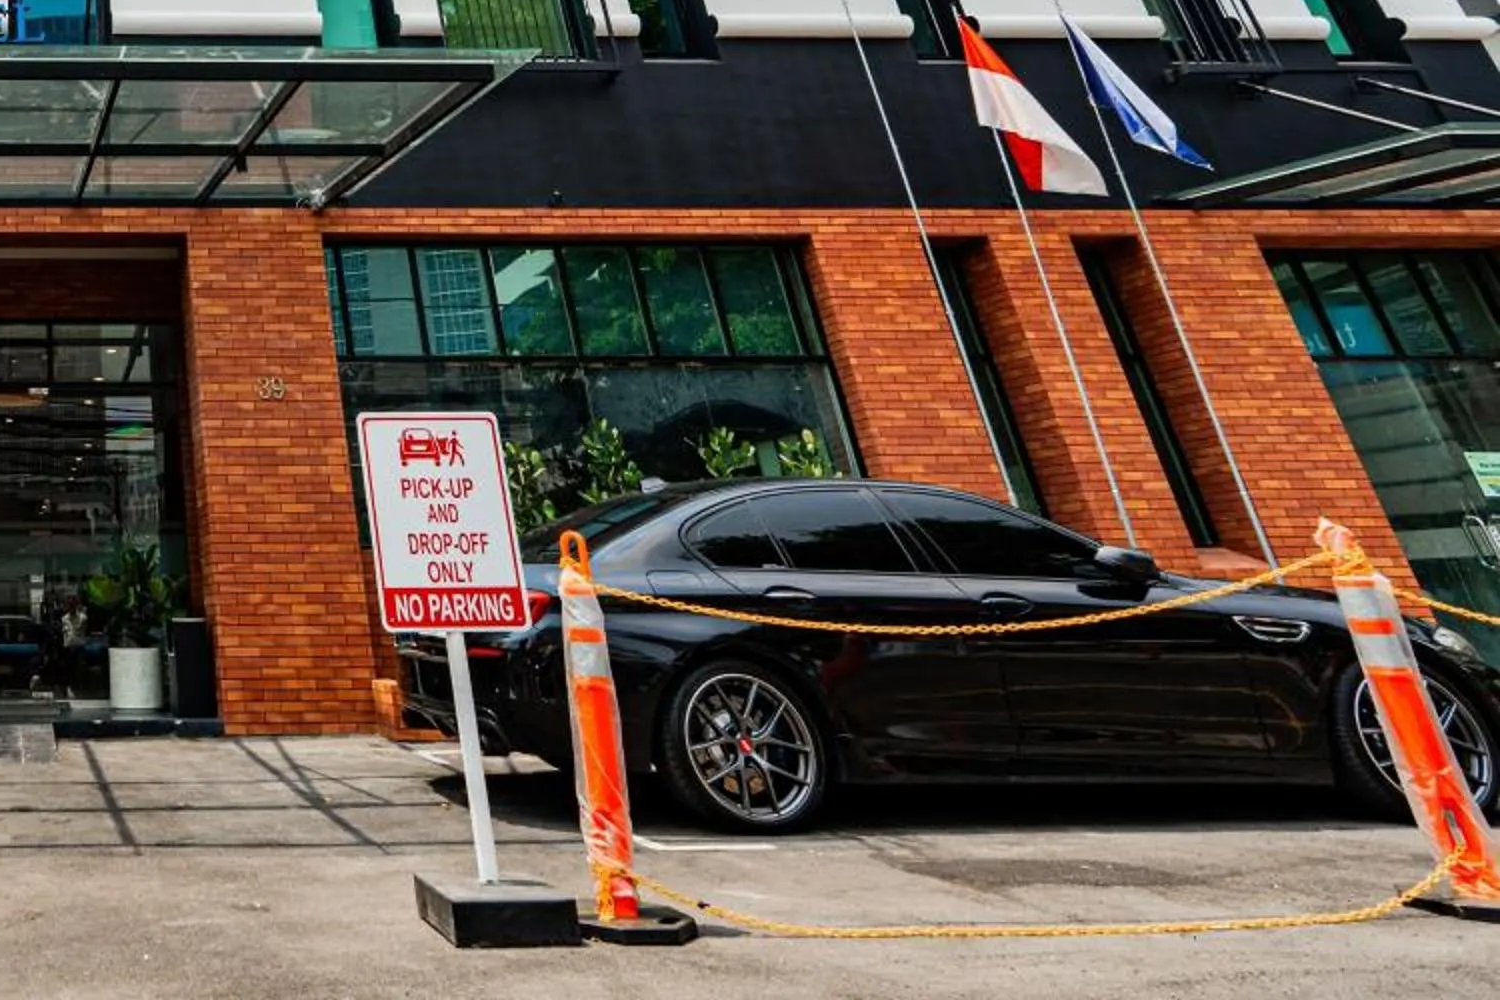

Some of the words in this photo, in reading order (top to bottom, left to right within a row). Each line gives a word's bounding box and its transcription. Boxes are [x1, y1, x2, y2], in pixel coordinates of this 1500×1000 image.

[257, 376, 285, 399] 39
[400, 477, 474, 499] PICK-UP
[427, 503, 459, 524] AND
[407, 532, 490, 555] DROP-OFF
[427, 561, 474, 583] ONLY
[394, 594, 424, 623] NO
[429, 593, 514, 622] PARKING
